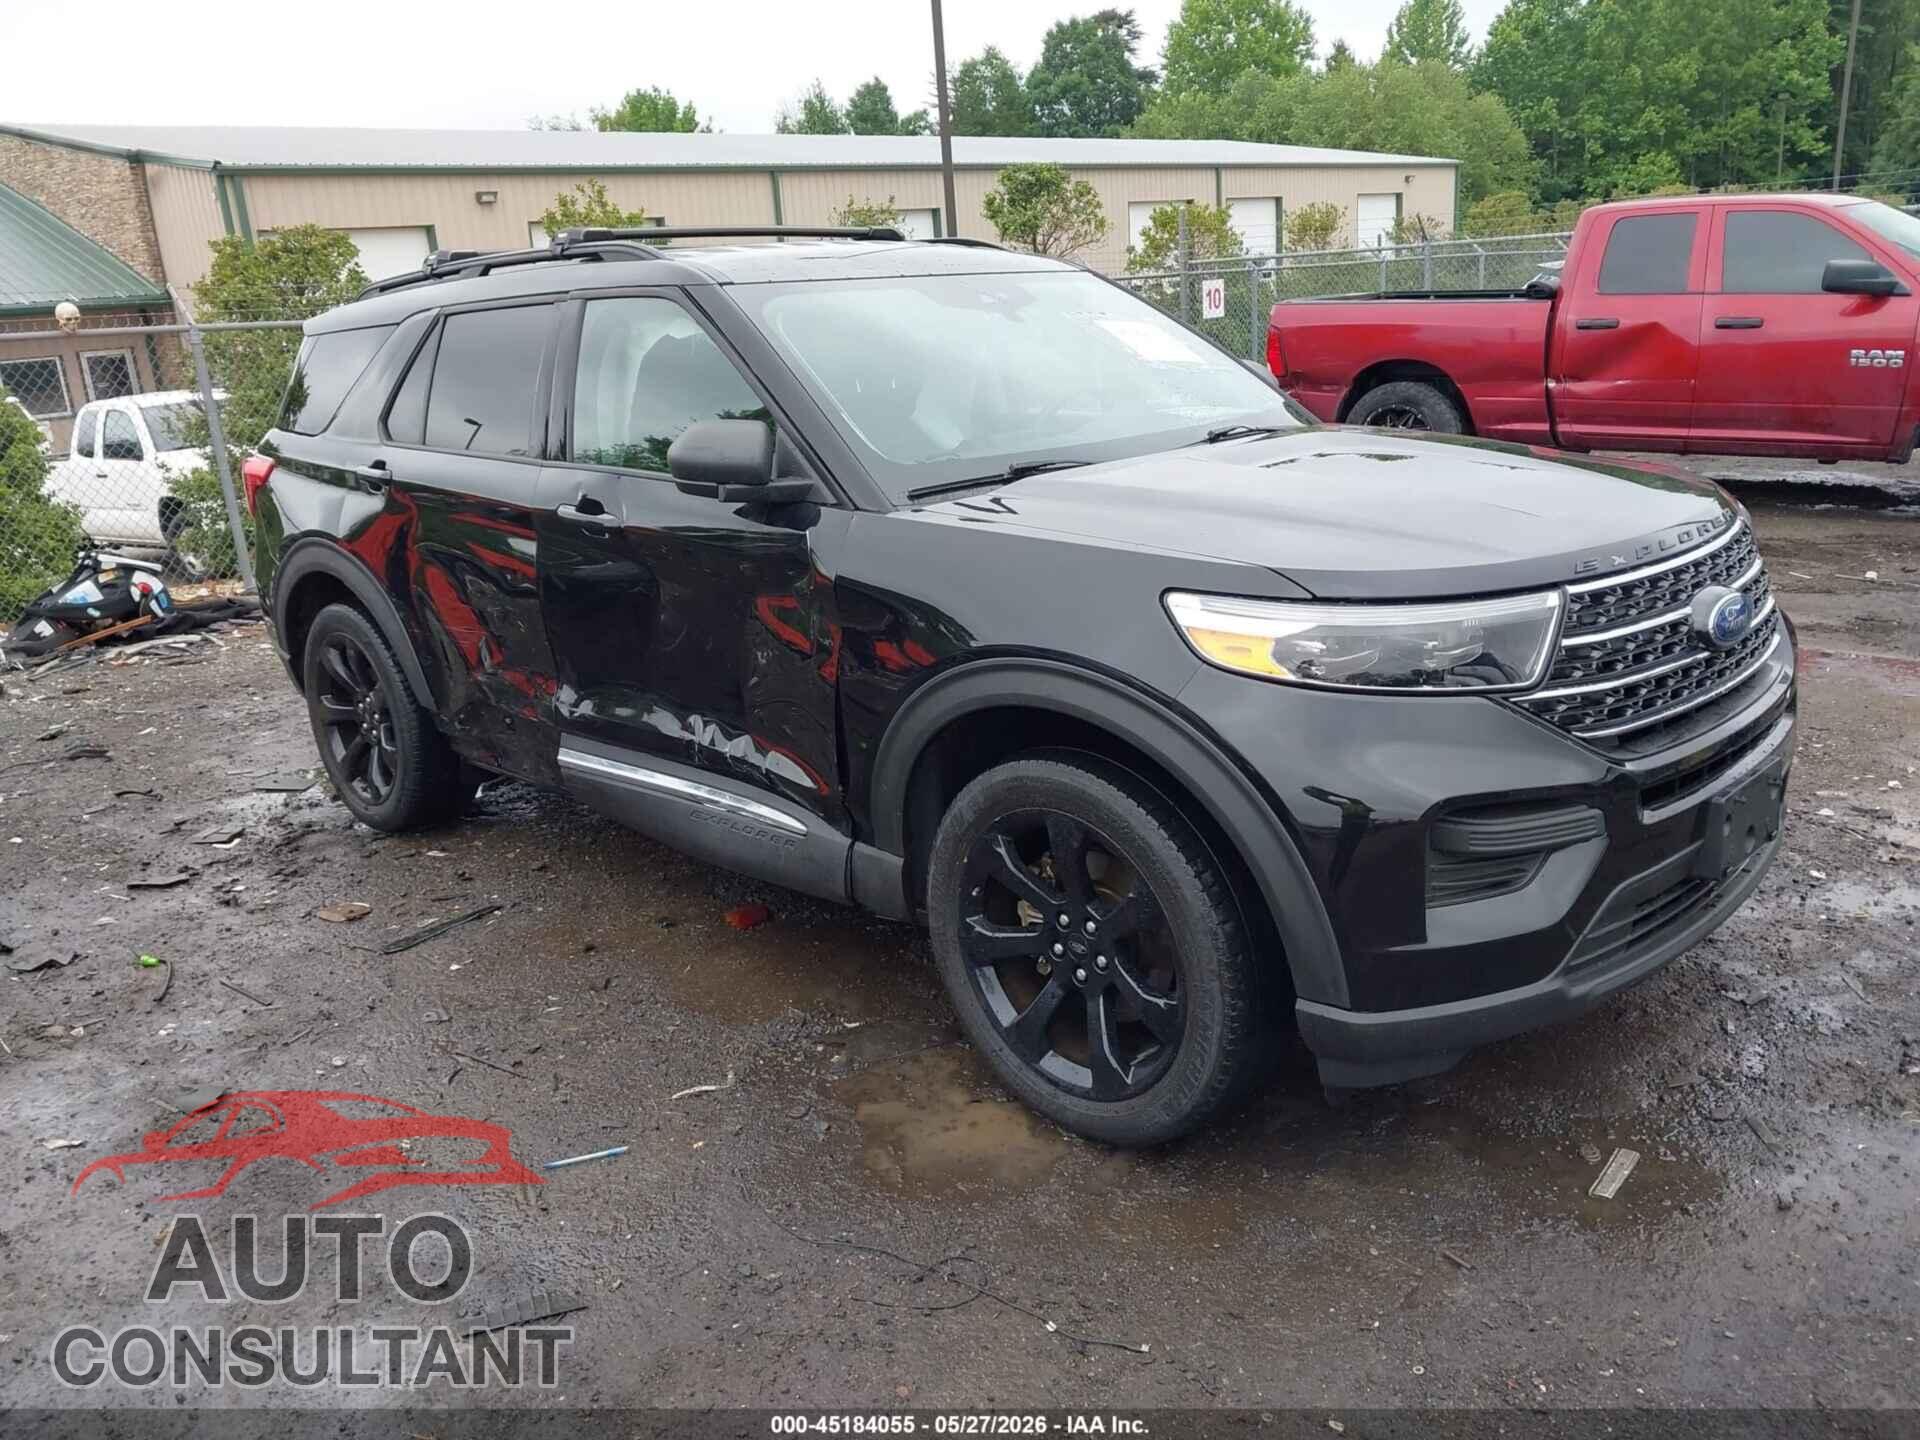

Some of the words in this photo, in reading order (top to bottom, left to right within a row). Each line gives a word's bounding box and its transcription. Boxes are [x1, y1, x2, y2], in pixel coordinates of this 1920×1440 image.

[1205, 287, 1222, 310] 10
[1850, 349, 1905, 359] RAM
[1850, 358, 1904, 368] 1500
[1573, 508, 1735, 575] EXPLORER
[689, 808, 798, 850] EXPLORER
